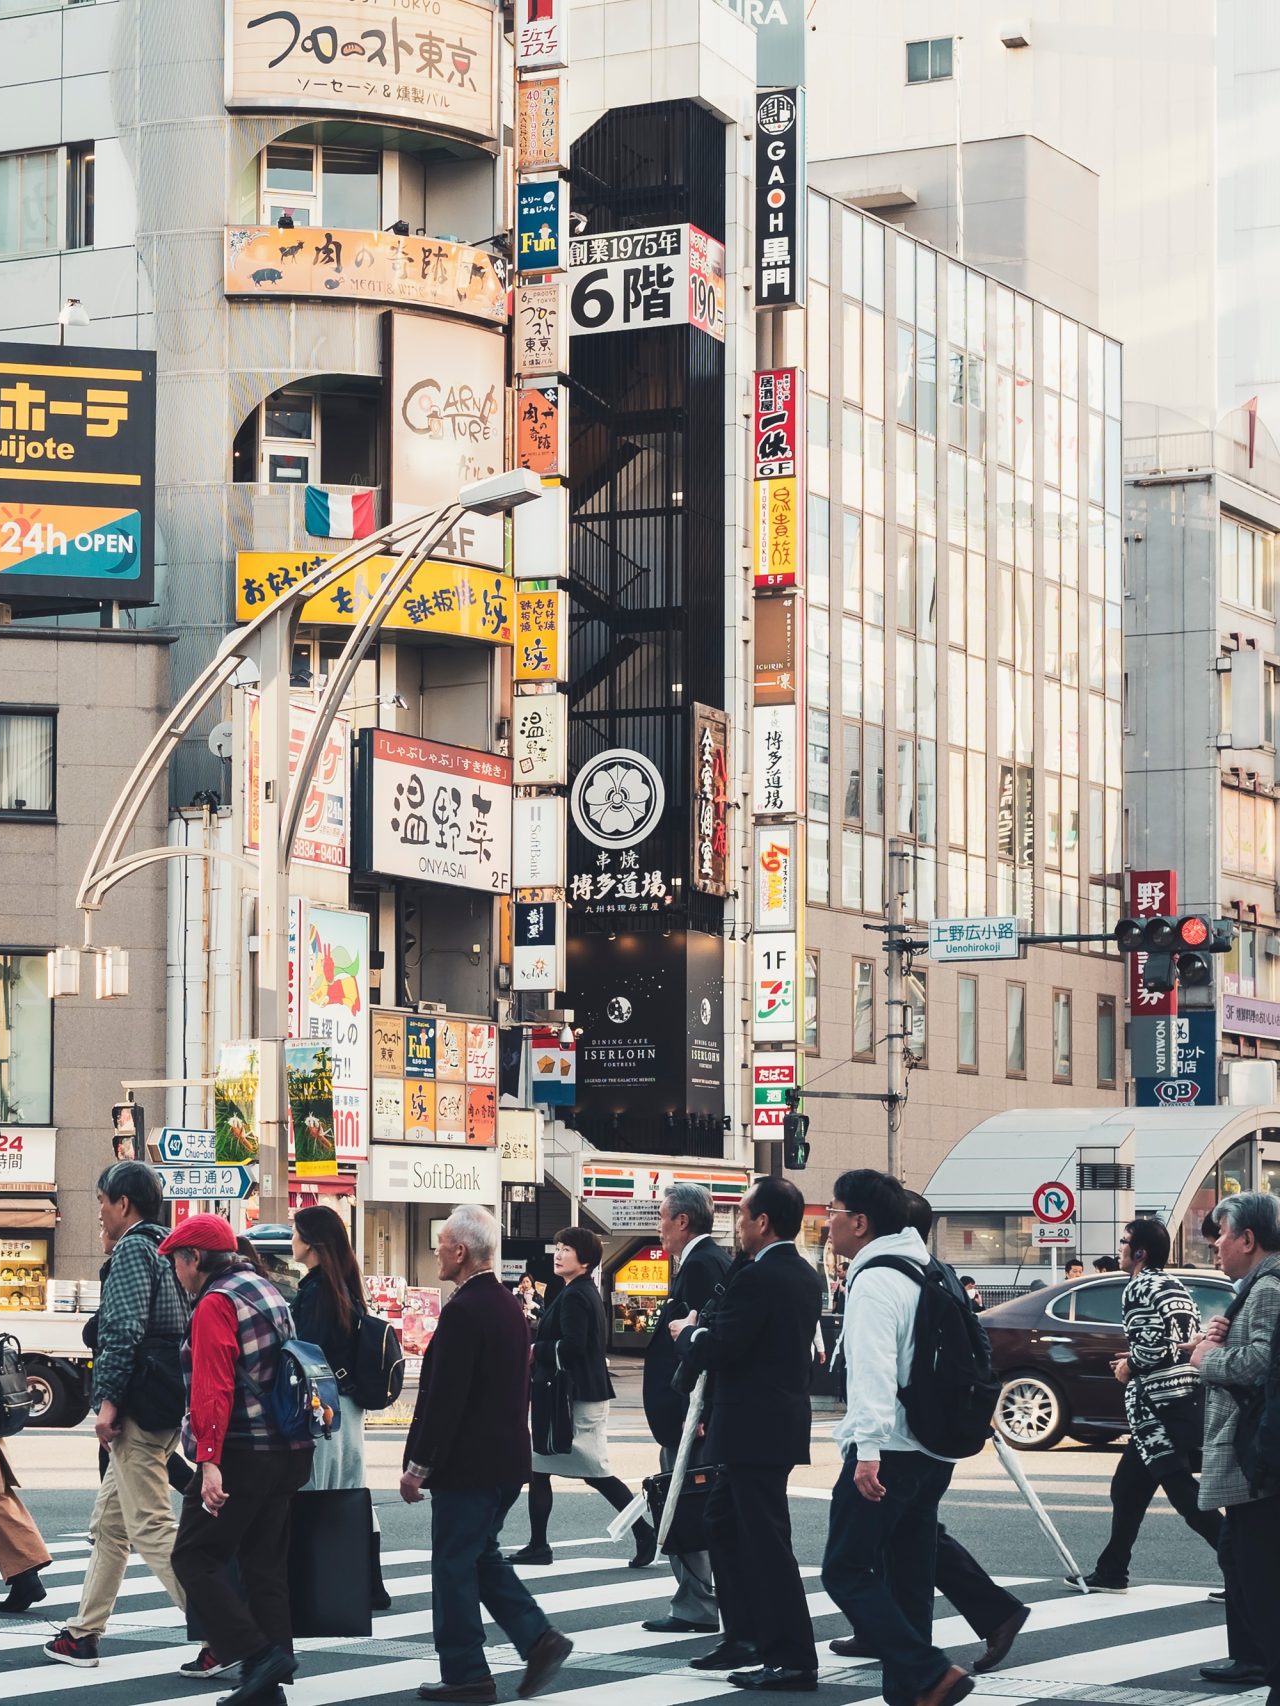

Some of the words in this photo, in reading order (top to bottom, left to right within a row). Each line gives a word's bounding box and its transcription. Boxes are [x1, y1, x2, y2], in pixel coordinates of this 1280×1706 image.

[520, 41, 557, 57] エステ
[520, 231, 557, 254] Fun
[570, 231, 679, 266] 創業1975年
[570, 263, 675, 328] 6階
[524, 337, 551, 353] 東京
[759, 376, 774, 412] 居酒屋
[758, 412, 789, 461] 一休
[759, 461, 792, 476] 6F
[771, 486, 791, 566] 鳥貴族
[0, 521, 67, 556] 24h
[74, 532, 134, 554] OPEN
[767, 575, 783, 585] 5F
[765, 730, 784, 810] 博多道場
[530, 825, 541, 878] SoftBank
[596, 850, 640, 871] 串焼
[418, 856, 467, 880] ONYASAI
[491, 871, 508, 889] 2F
[570, 870, 667, 900] 博多道場
[585, 903, 660, 913] 九州料理居酒屋
[932, 923, 1014, 942] 上野広小路
[945, 943, 1001, 955] Uenohirokoji
[762, 951, 787, 970] 1F
[408, 1035, 431, 1058] Fun
[584, 1049, 656, 1060] ISERLOHN
[1156, 1021, 1166, 1073] NOMURA
[474, 1066, 495, 1079] エステ
[758, 1068, 790, 1081] たばこ
[766, 1090, 782, 1103] 酒
[1162, 1082, 1191, 1101] QB
[185, 1148, 214, 1158] Chuo-dori
[173, 1170, 233, 1184] 春日通り
[413, 1161, 480, 1190] SoftBank
[170, 1186, 217, 1196] Kasuga-dori
[220, 1186, 237, 1195] Ave.
[650, 1251, 662, 1259] 5F
